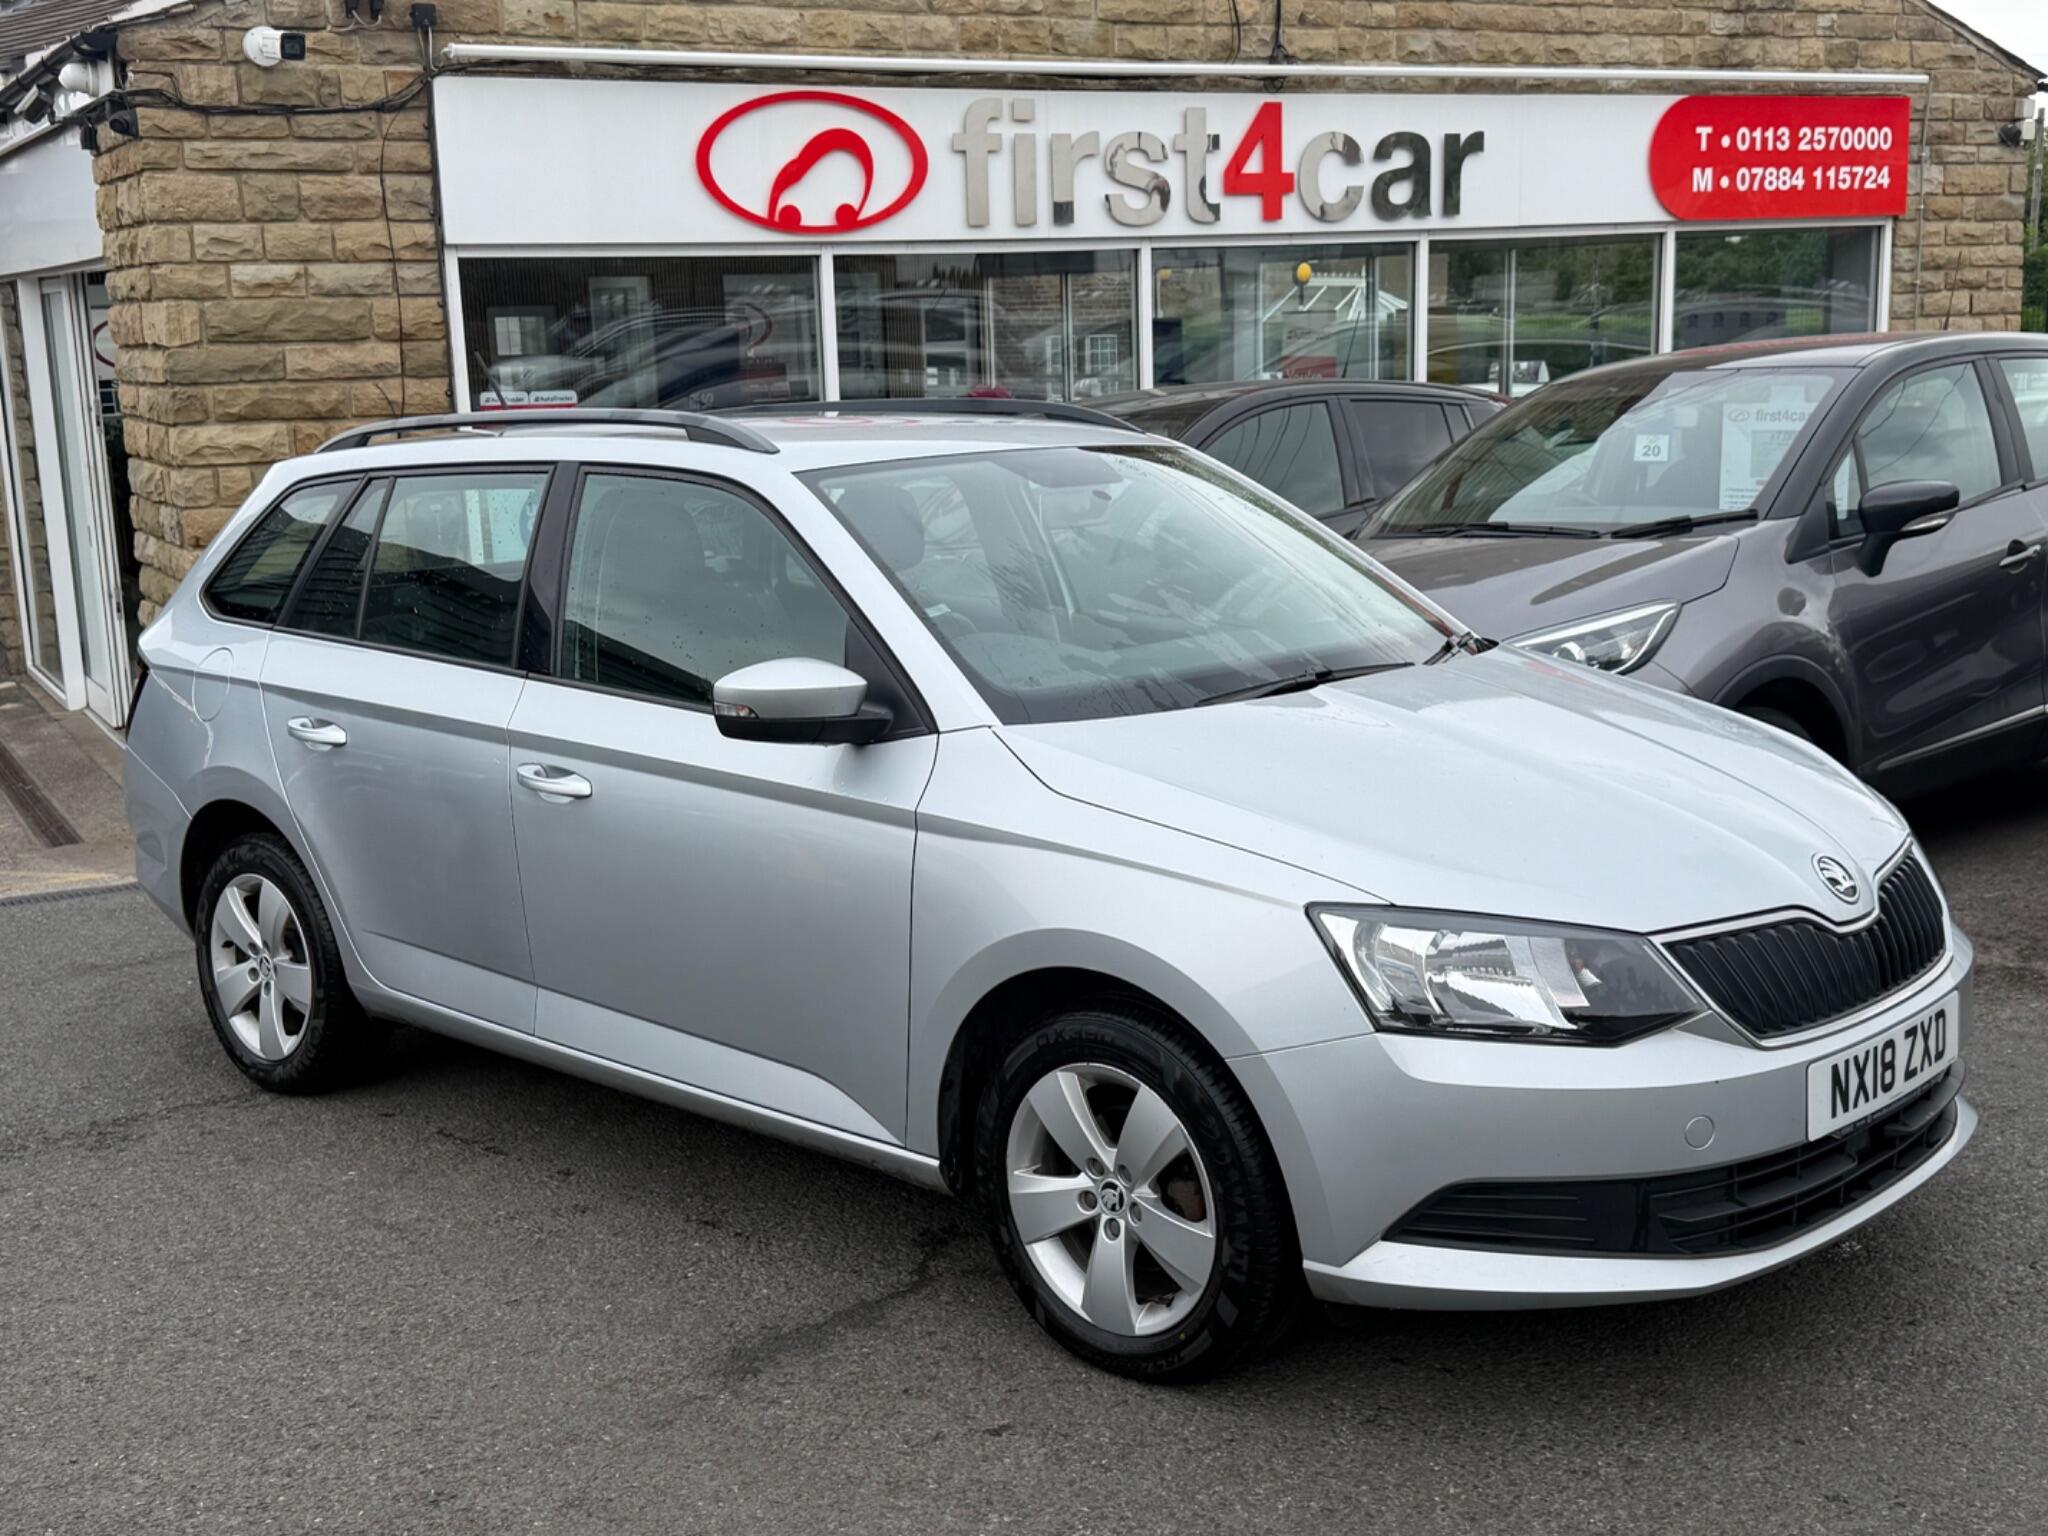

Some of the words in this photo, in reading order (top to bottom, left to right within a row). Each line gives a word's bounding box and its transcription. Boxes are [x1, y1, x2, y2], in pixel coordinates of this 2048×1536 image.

[1696, 126, 1713, 151] T
[1736, 126, 1790, 151] 0113
[1798, 126, 1892, 151] 2570000
[951, 98, 1485, 228] first4car
[1692, 167, 1713, 192] M
[1736, 167, 1805, 191] 07884
[1812, 166, 1891, 190] 115724
[1756, 409, 1810, 422] first4ca
[1642, 445, 1661, 457] 20
[1831, 1037, 1896, 1120] NX18
[1904, 1008, 1946, 1083] ZXD
